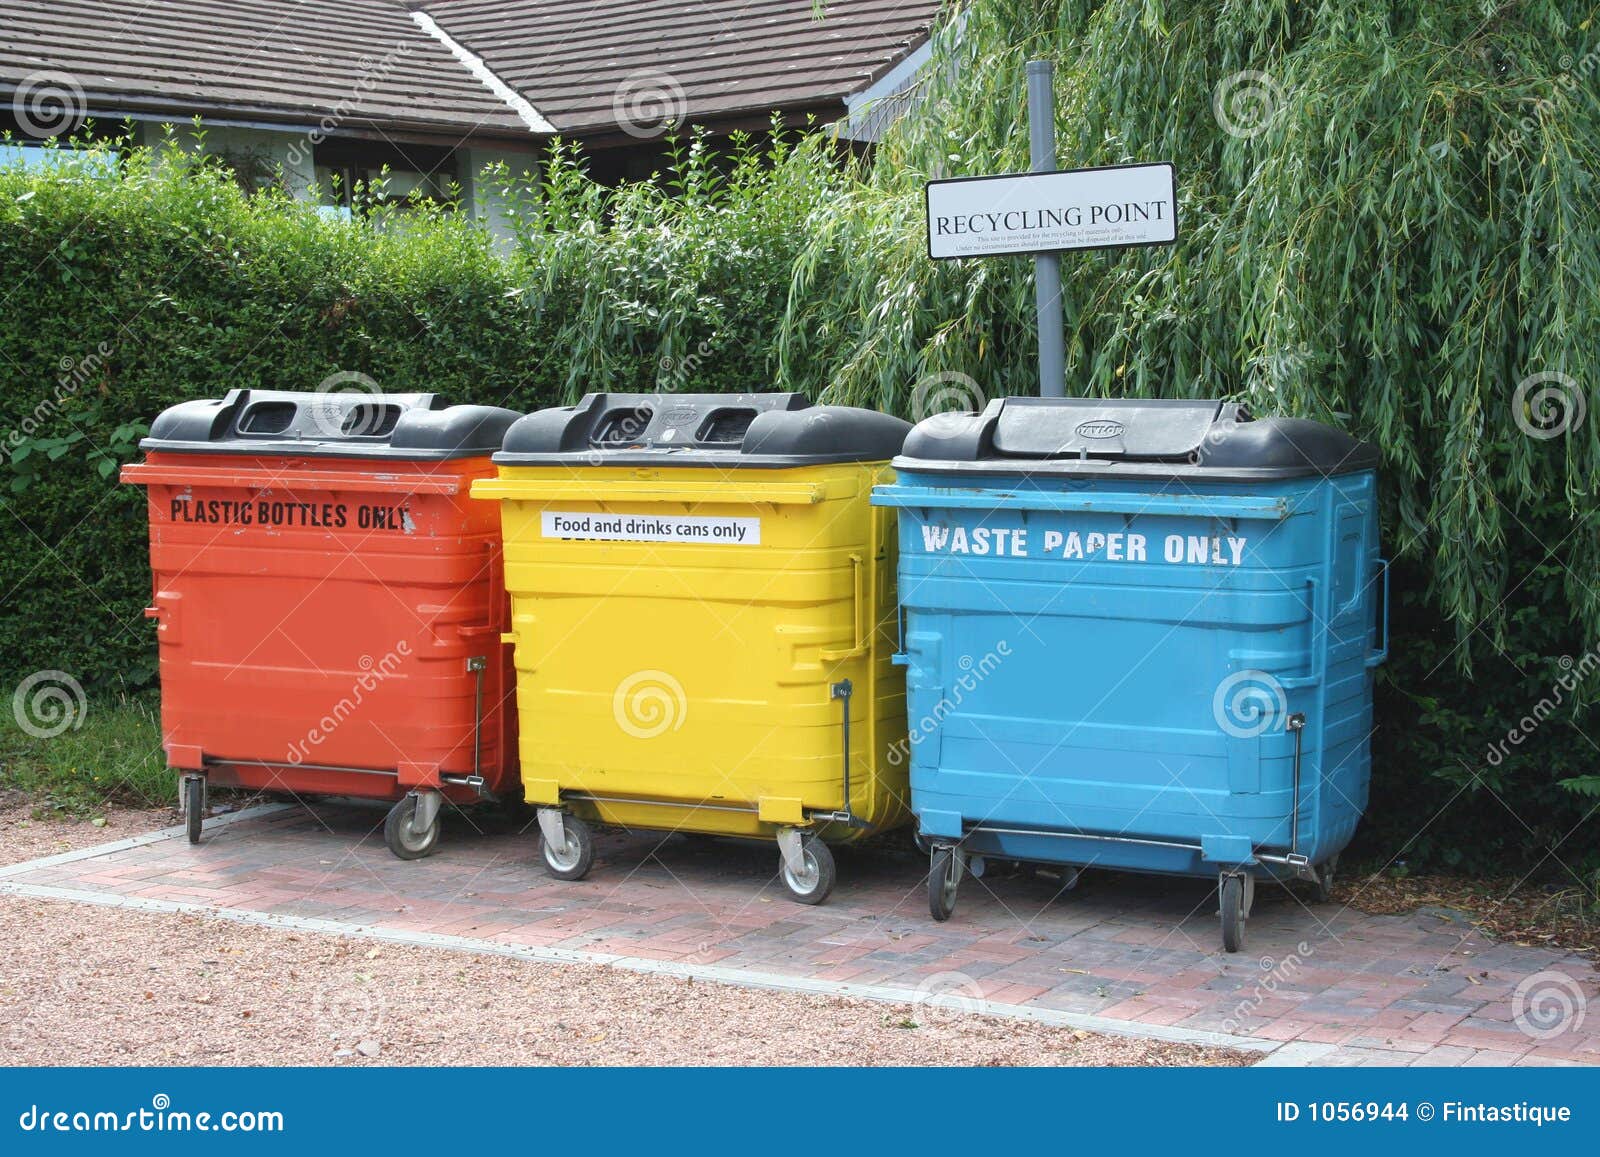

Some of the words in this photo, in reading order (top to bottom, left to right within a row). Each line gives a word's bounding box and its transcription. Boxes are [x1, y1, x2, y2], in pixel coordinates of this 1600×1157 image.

[936, 207, 1081, 235] RECYCLING
[1091, 201, 1167, 224] POINT
[170, 500, 253, 525] PLASTIC
[258, 501, 347, 528] BOTTLES
[554, 517, 590, 532] Food
[594, 519, 622, 534] and
[626, 520, 672, 535] drinks
[676, 524, 709, 537] cans
[713, 522, 746, 541] only
[921, 525, 1027, 557] WASTE
[1043, 531, 1147, 561] PAPER
[1164, 534, 1247, 565] ONLY
